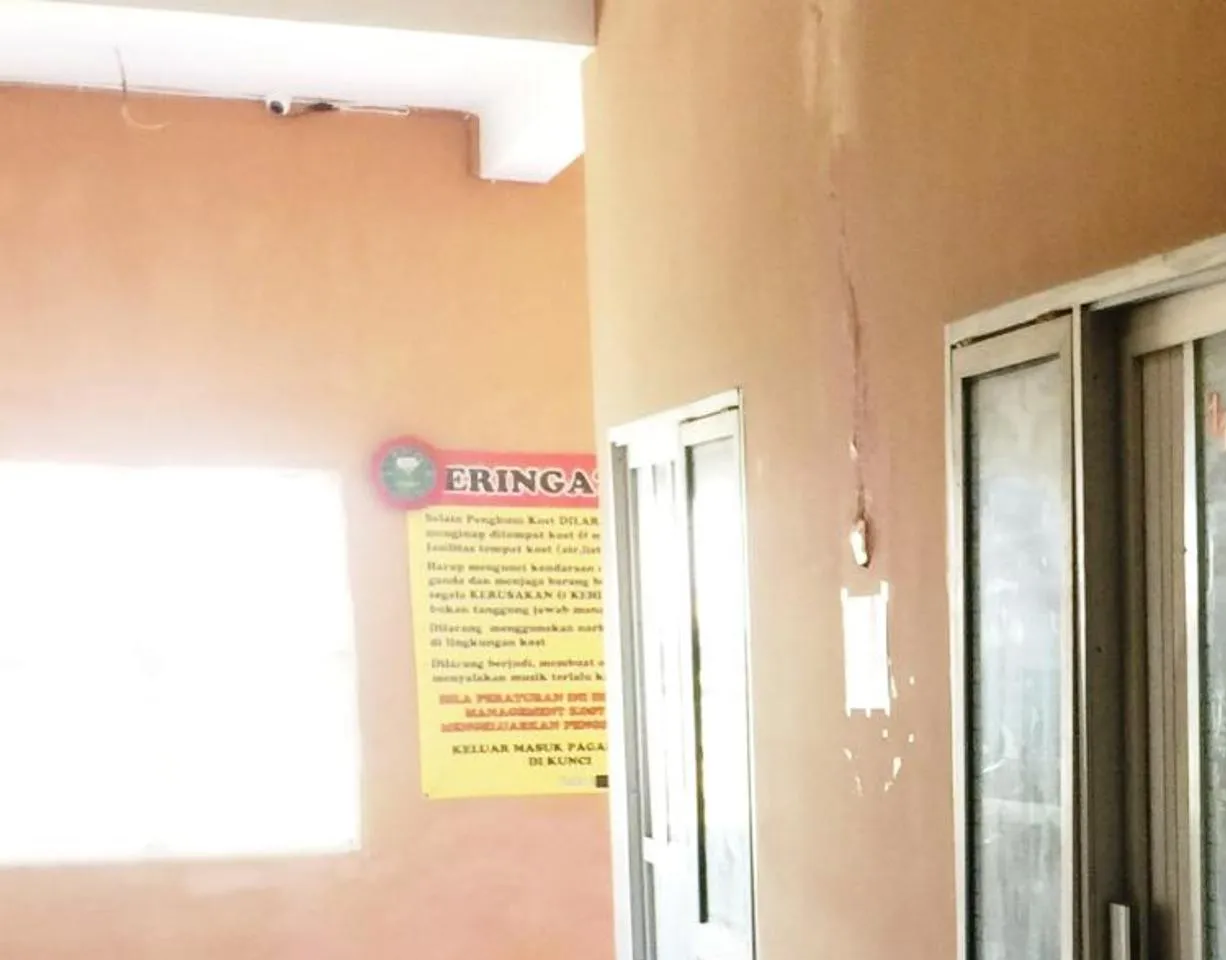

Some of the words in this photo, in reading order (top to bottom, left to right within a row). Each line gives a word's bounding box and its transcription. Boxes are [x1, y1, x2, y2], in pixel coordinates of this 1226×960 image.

[444, 466, 599, 495] ERINGA
[452, 743, 510, 755] KELUAR
[512, 743, 563, 753] MASUK
[567, 742, 606, 752] PAGA
[528, 757, 543, 766] DI
[547, 756, 592, 766] KUNCI
